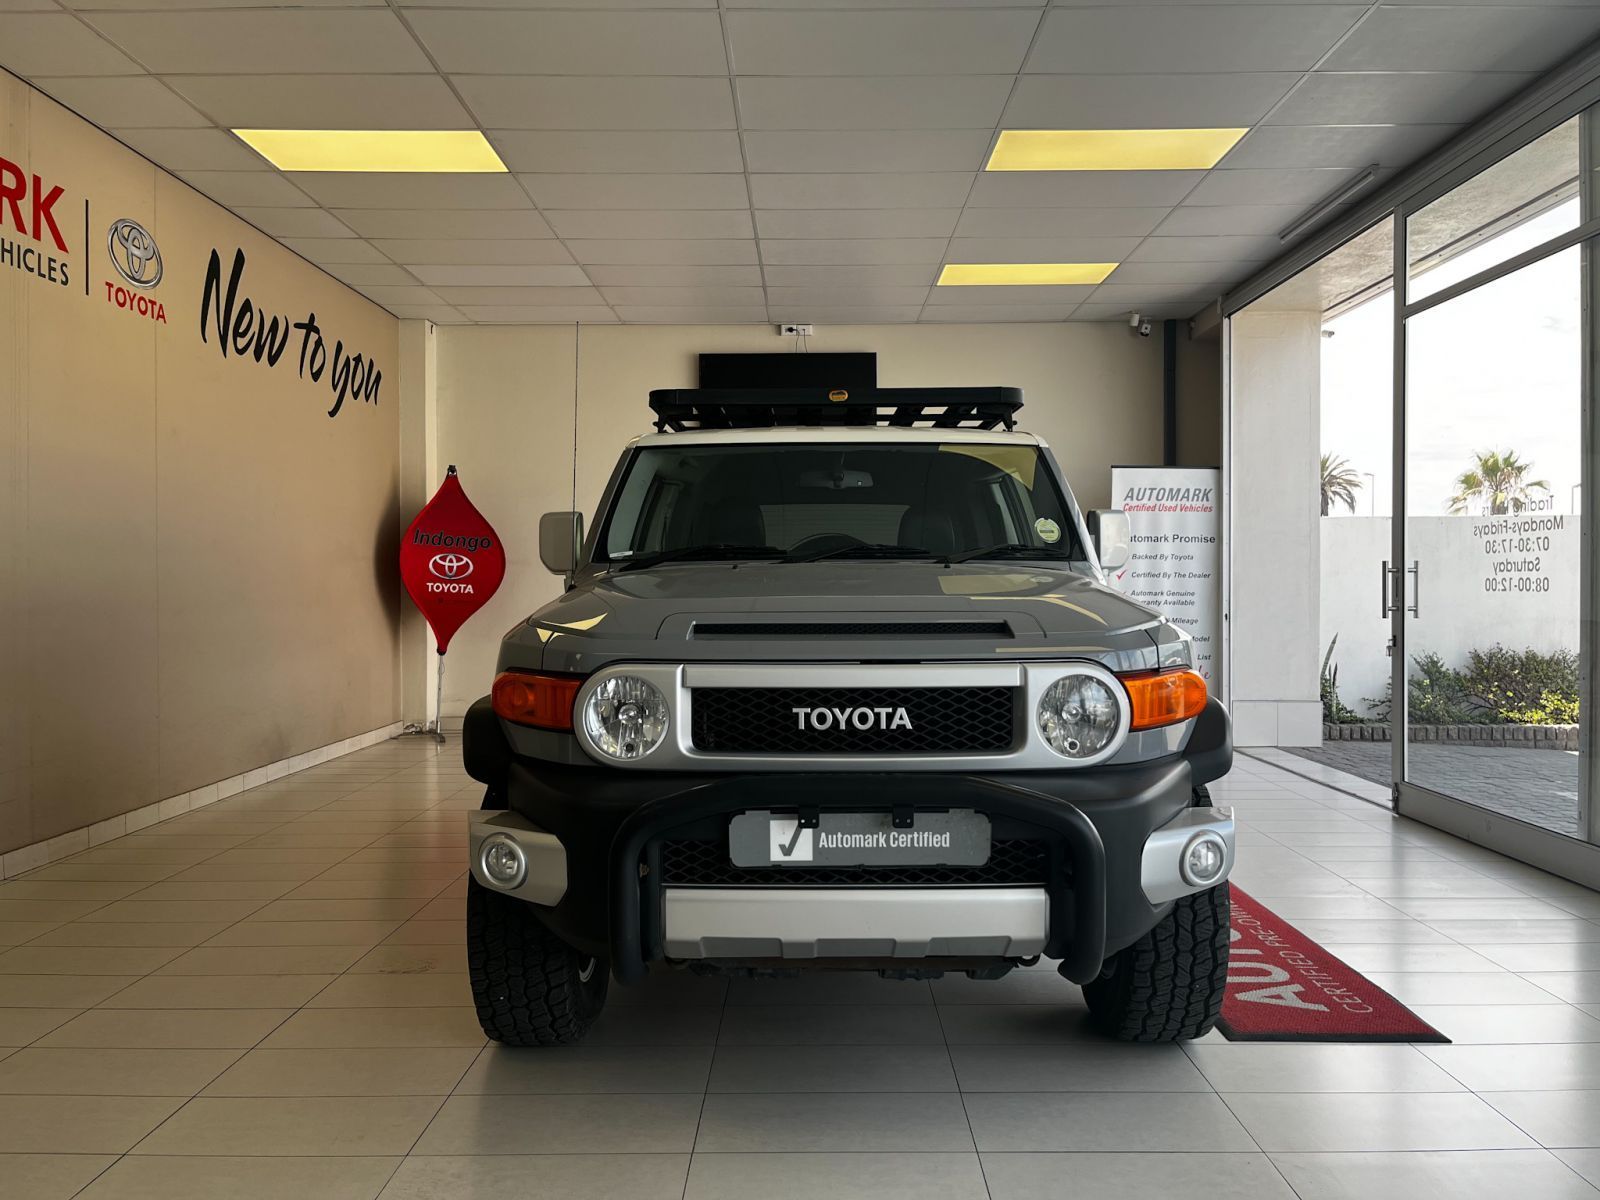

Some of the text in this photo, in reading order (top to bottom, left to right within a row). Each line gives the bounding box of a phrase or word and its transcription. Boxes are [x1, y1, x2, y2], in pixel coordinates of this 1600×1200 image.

[105, 281, 167, 324] TOYOTA
[200, 248, 382, 418] New to you
[1123, 487, 1213, 502] AUTOMARK
[1123, 503, 1214, 513] Certified Used Vehicles
[413, 528, 492, 552] Indongo
[1130, 533, 1216, 543] tomark Promise
[1159, 553, 1169, 562] By
[1171, 553, 1194, 562] Toyota
[1131, 571, 1212, 580] Certified By The Dealer
[426, 583, 474, 594] TOYOTA
[1163, 599, 1196, 607] Available
[1171, 617, 1199, 626] Mileage
[1197, 653, 1212, 661] List
[792, 707, 913, 730] TOYOTA
[819, 831, 951, 848] Automark Certified
[1279, 950, 1374, 1013] CERTIFIED
